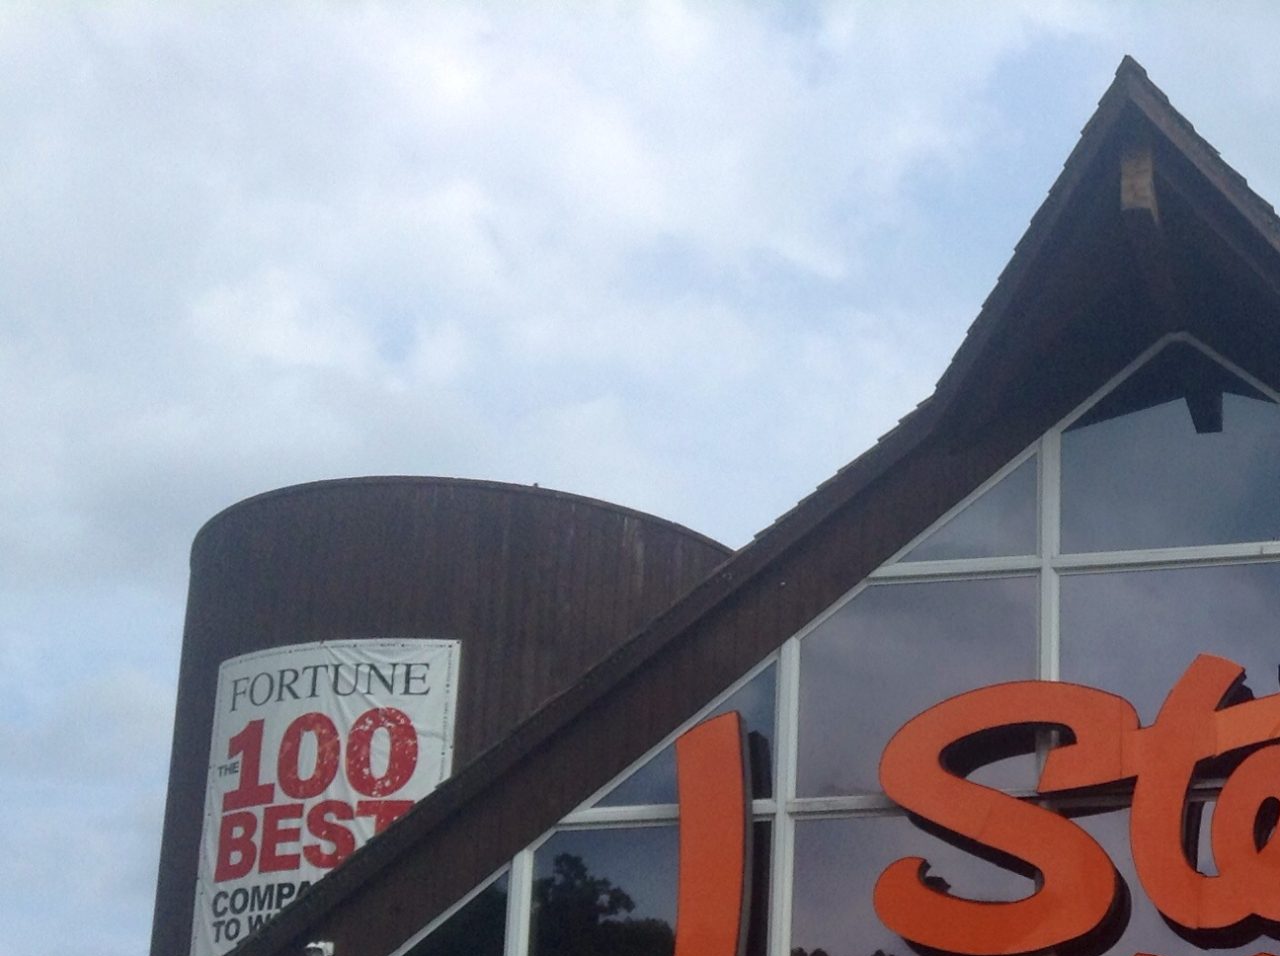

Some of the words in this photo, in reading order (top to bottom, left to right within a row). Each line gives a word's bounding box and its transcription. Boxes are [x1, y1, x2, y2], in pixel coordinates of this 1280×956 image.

[229, 662, 431, 712] FORTUNE
[217, 761, 240, 778] THE
[221, 706, 419, 812] 100
[213, 799, 416, 883] BEST
[211, 918, 241, 944] TO
